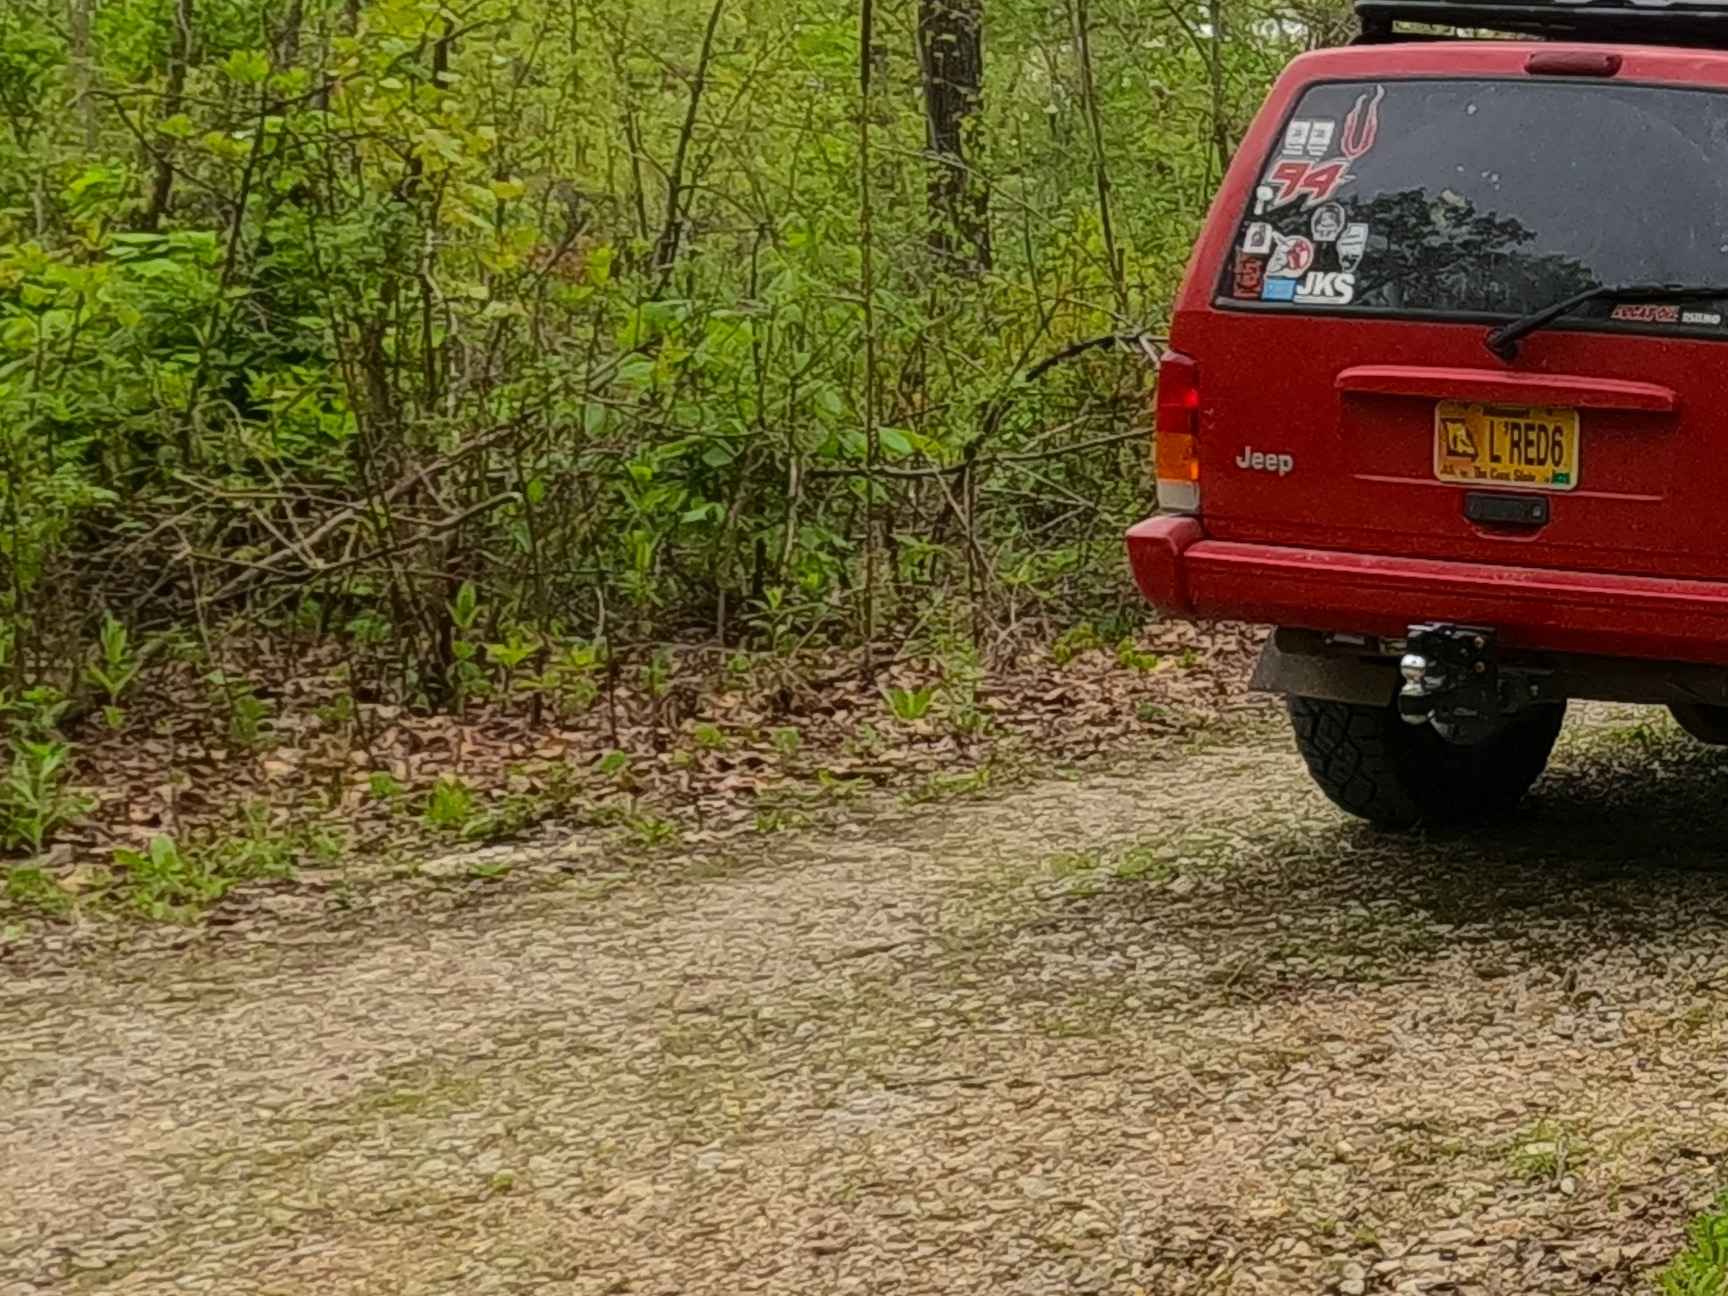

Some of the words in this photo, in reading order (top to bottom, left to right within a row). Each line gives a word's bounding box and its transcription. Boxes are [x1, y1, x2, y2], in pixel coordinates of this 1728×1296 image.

[1268, 159, 1346, 206] 94
[1295, 271, 1356, 305] JKS
[1235, 445, 1294, 477] Jeep
[1489, 420, 1563, 467] L'RED6
